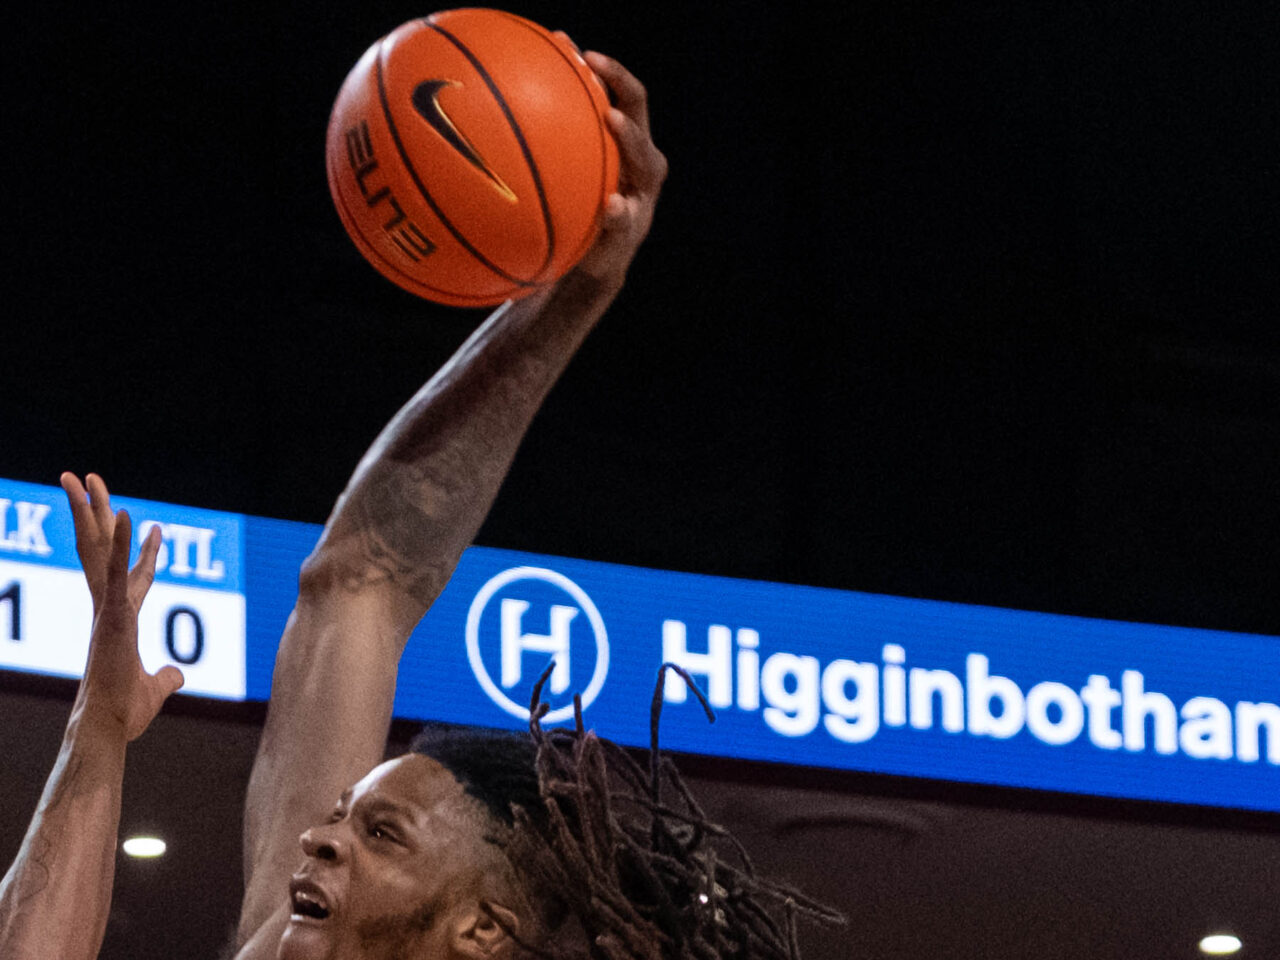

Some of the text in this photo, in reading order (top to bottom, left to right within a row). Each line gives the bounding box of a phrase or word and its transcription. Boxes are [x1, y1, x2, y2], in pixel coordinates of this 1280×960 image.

[345, 120, 438, 263] ELITE
[139, 519, 225, 579] STL
[165, 606, 205, 665] 0
[500, 597, 579, 695] H
